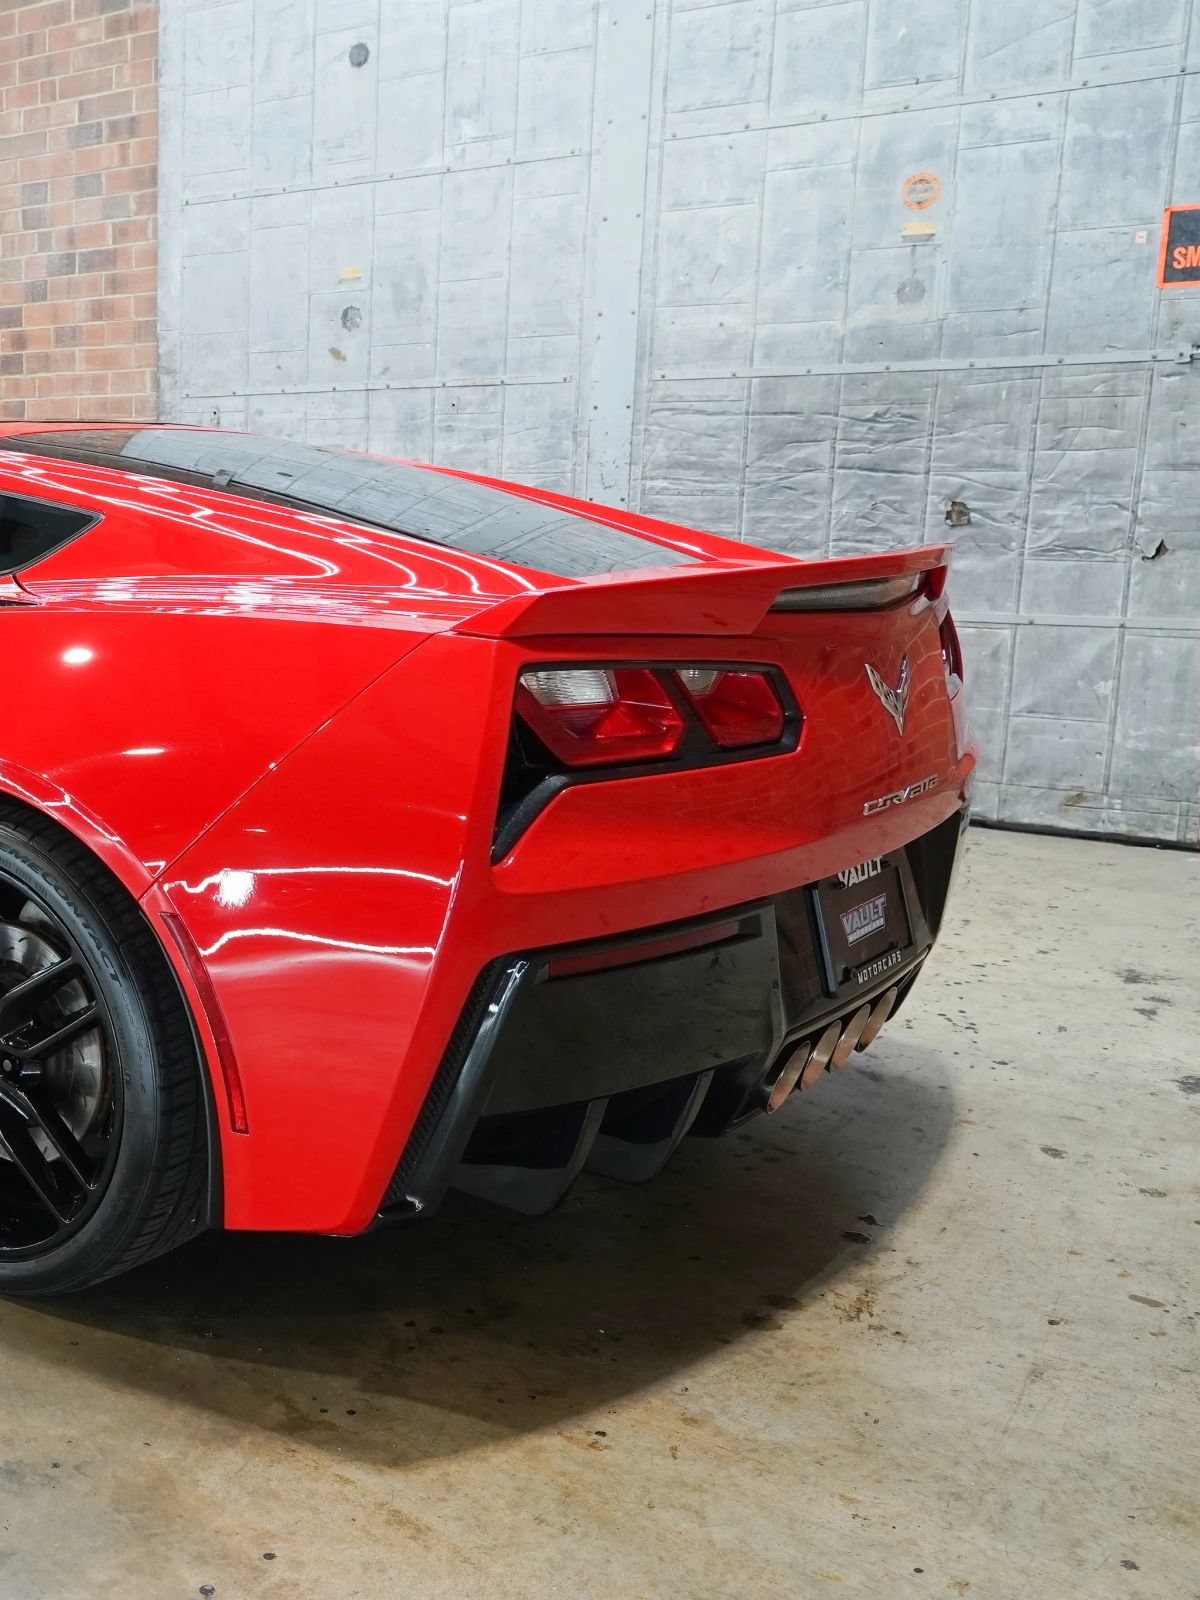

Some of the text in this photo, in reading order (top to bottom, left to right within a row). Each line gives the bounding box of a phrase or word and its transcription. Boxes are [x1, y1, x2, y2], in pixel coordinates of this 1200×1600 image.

[863, 774, 938, 815] CORVETTE
[837, 855, 883, 889] VAULT
[841, 896, 885, 935] VAULT
[857, 951, 901, 984] MOTORCARS
